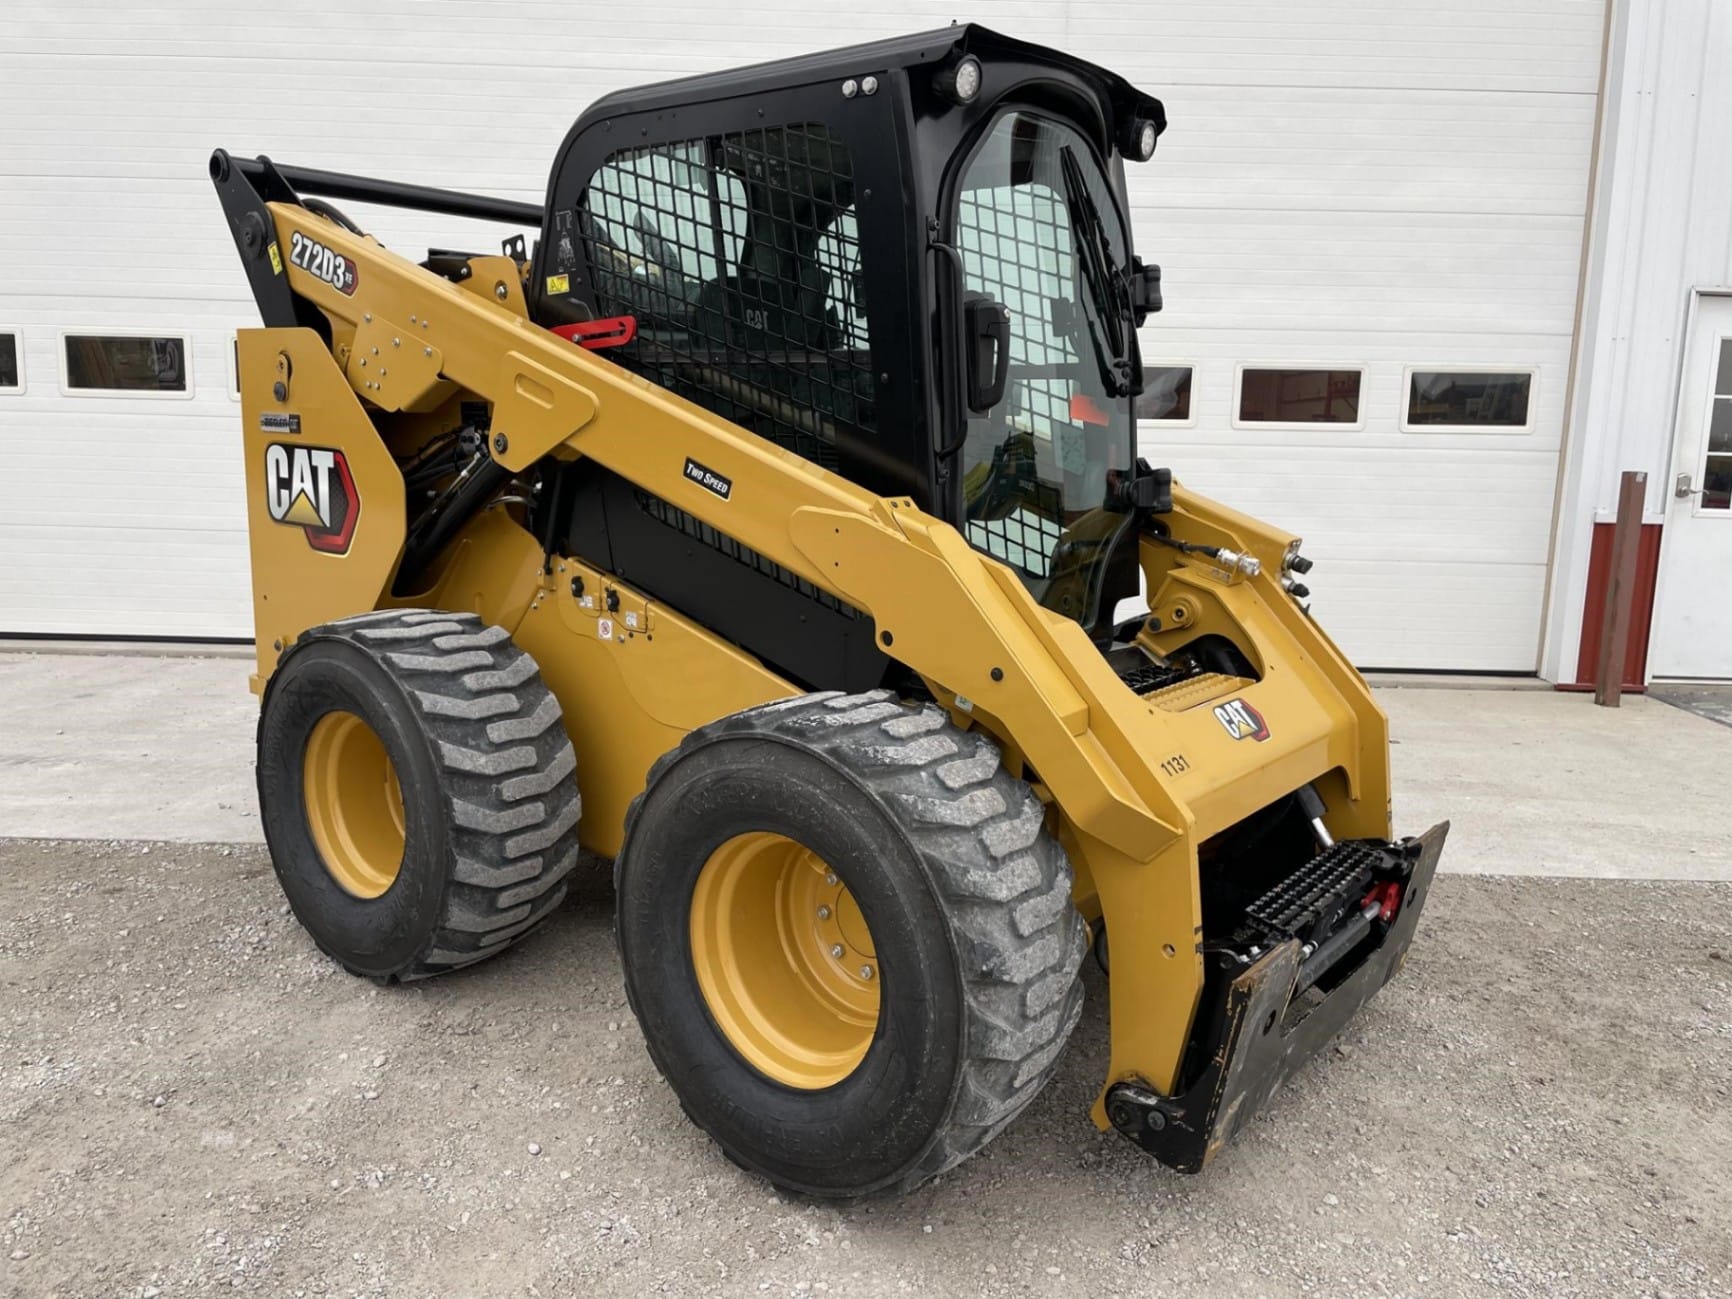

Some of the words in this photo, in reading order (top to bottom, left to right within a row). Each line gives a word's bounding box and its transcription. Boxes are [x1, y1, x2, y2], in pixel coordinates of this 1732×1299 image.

[291, 231, 345, 289] 272D3
[746, 309, 768, 331] CAT
[266, 444, 335, 528] CAT
[1213, 699, 1258, 739] CAT
[1160, 754, 1191, 777] 1131
